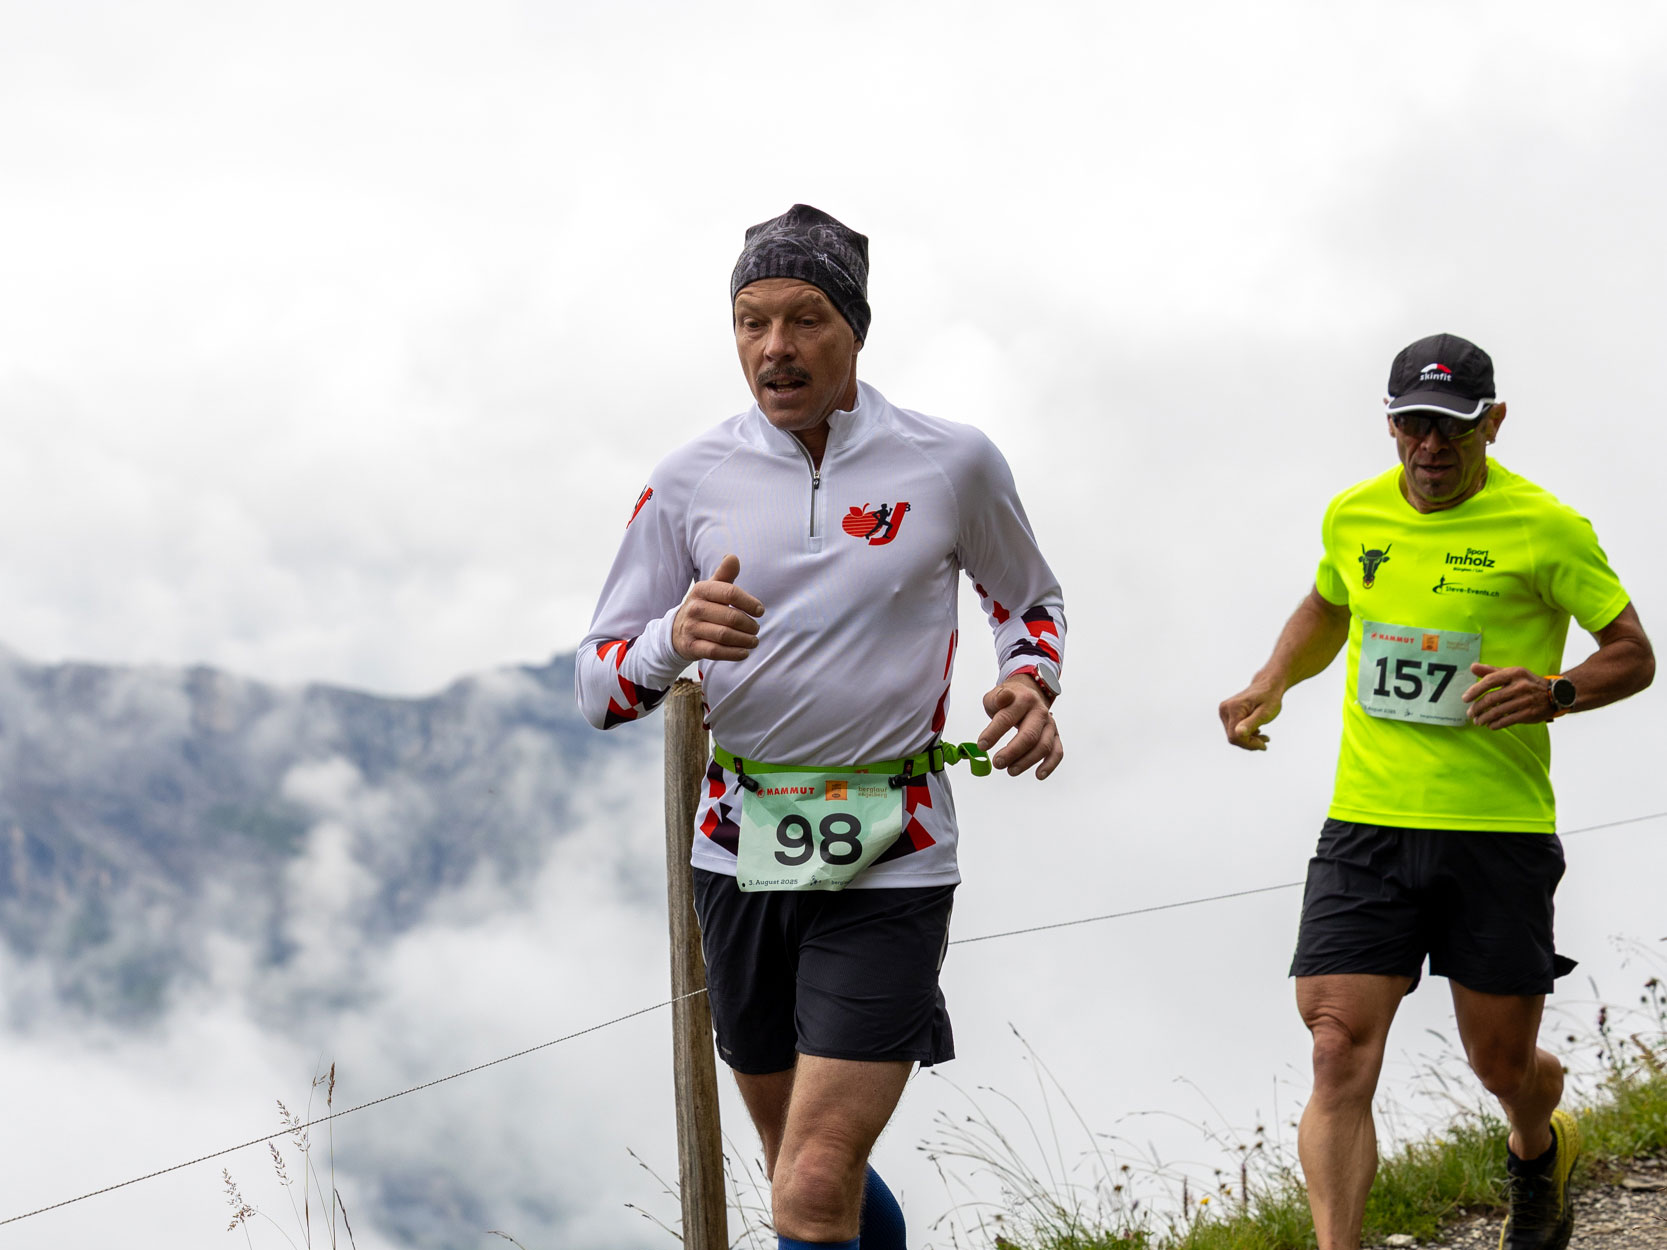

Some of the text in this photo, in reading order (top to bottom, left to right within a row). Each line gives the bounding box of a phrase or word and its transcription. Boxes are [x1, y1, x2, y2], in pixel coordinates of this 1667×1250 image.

[1419, 371, 1452, 382] skinfit
[1466, 547, 1489, 557] Sport
[1445, 552, 1496, 569] Imholz
[1373, 656, 1458, 703] 157
[767, 787, 815, 796] MAMMUT
[857, 784, 888, 794] berglauf
[774, 813, 863, 867] 98
